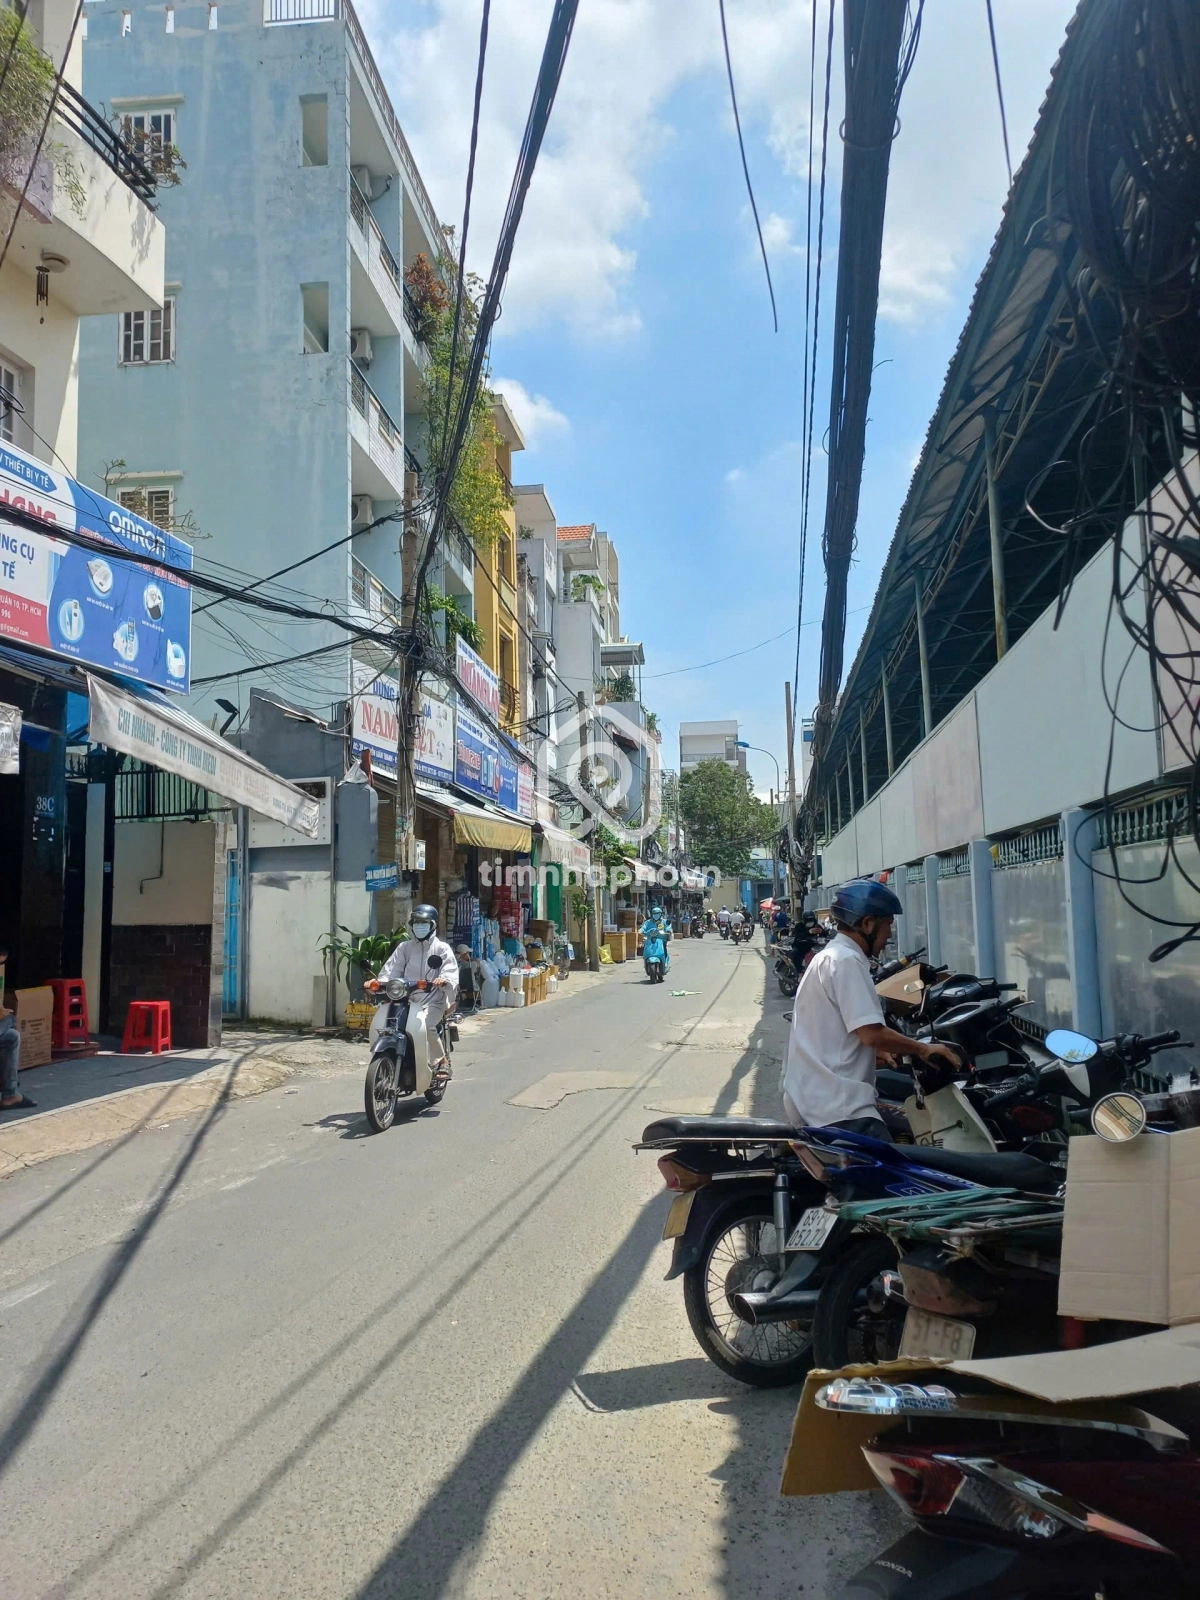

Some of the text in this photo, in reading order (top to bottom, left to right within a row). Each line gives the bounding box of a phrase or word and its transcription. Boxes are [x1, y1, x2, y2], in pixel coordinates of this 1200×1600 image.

[0, 533, 18, 554] NG
[361, 700, 399, 742] NAM
[36, 796, 54, 811] 38C
[874, 1559, 913, 1579] HONDA
